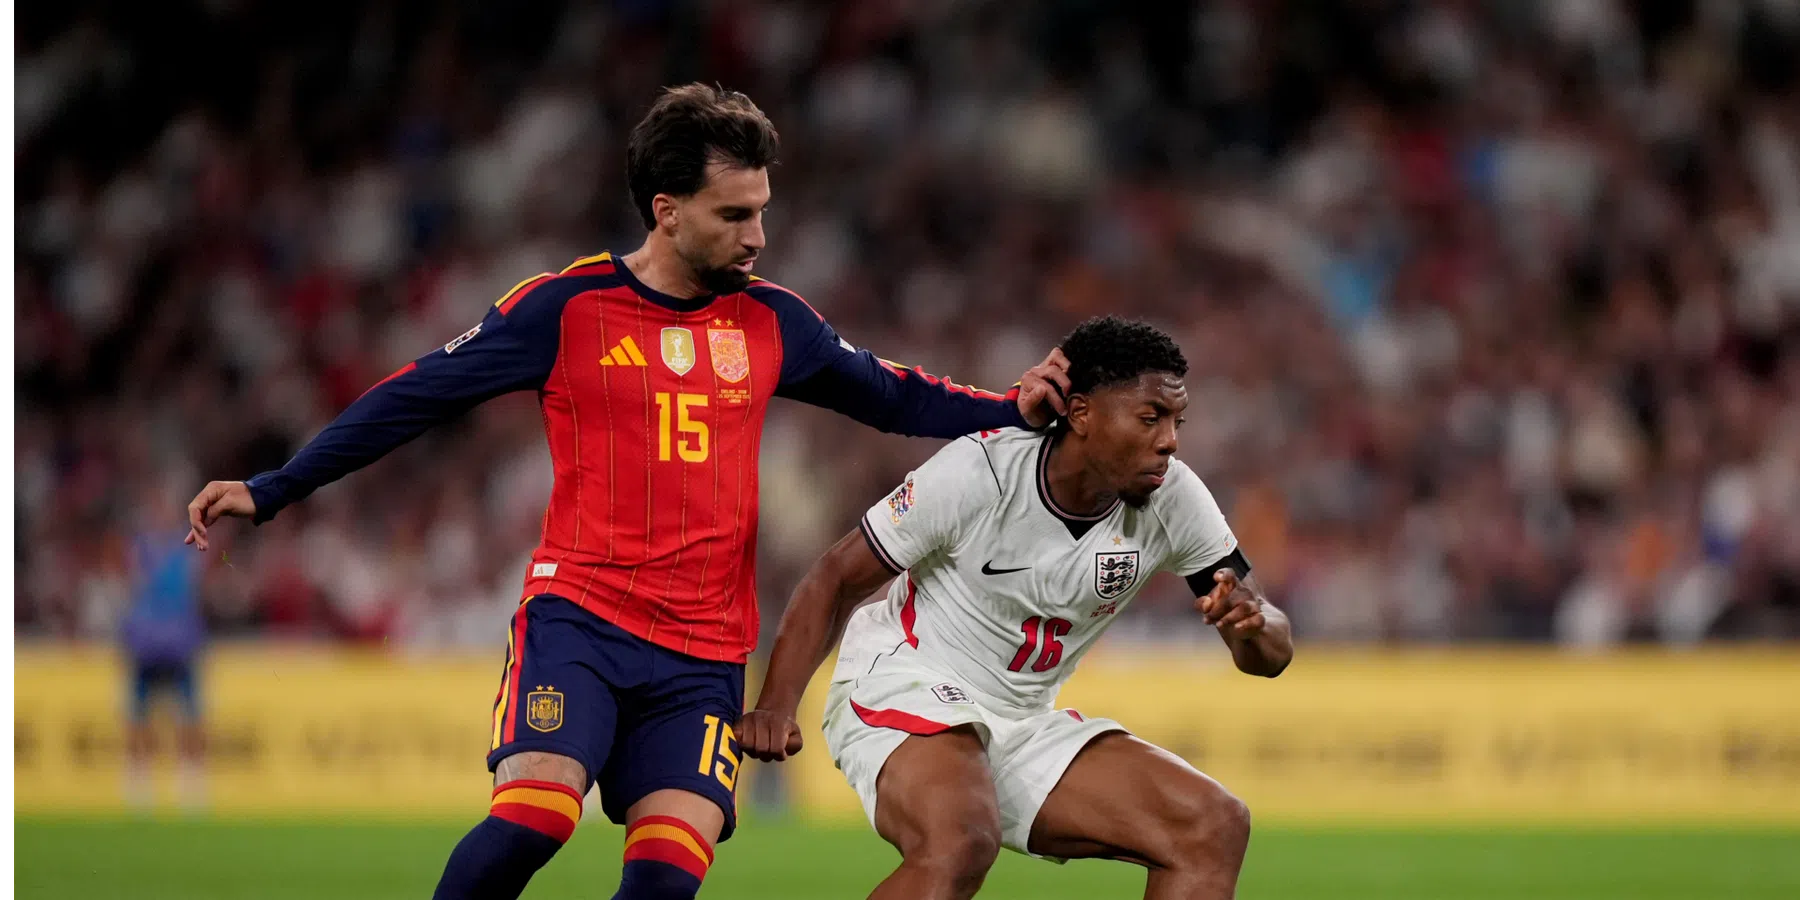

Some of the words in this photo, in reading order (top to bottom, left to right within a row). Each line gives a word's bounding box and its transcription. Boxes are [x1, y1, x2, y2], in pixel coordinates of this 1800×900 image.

[655, 392, 709, 463] 15
[1007, 615, 1073, 673] 16
[698, 714, 740, 792] 15
